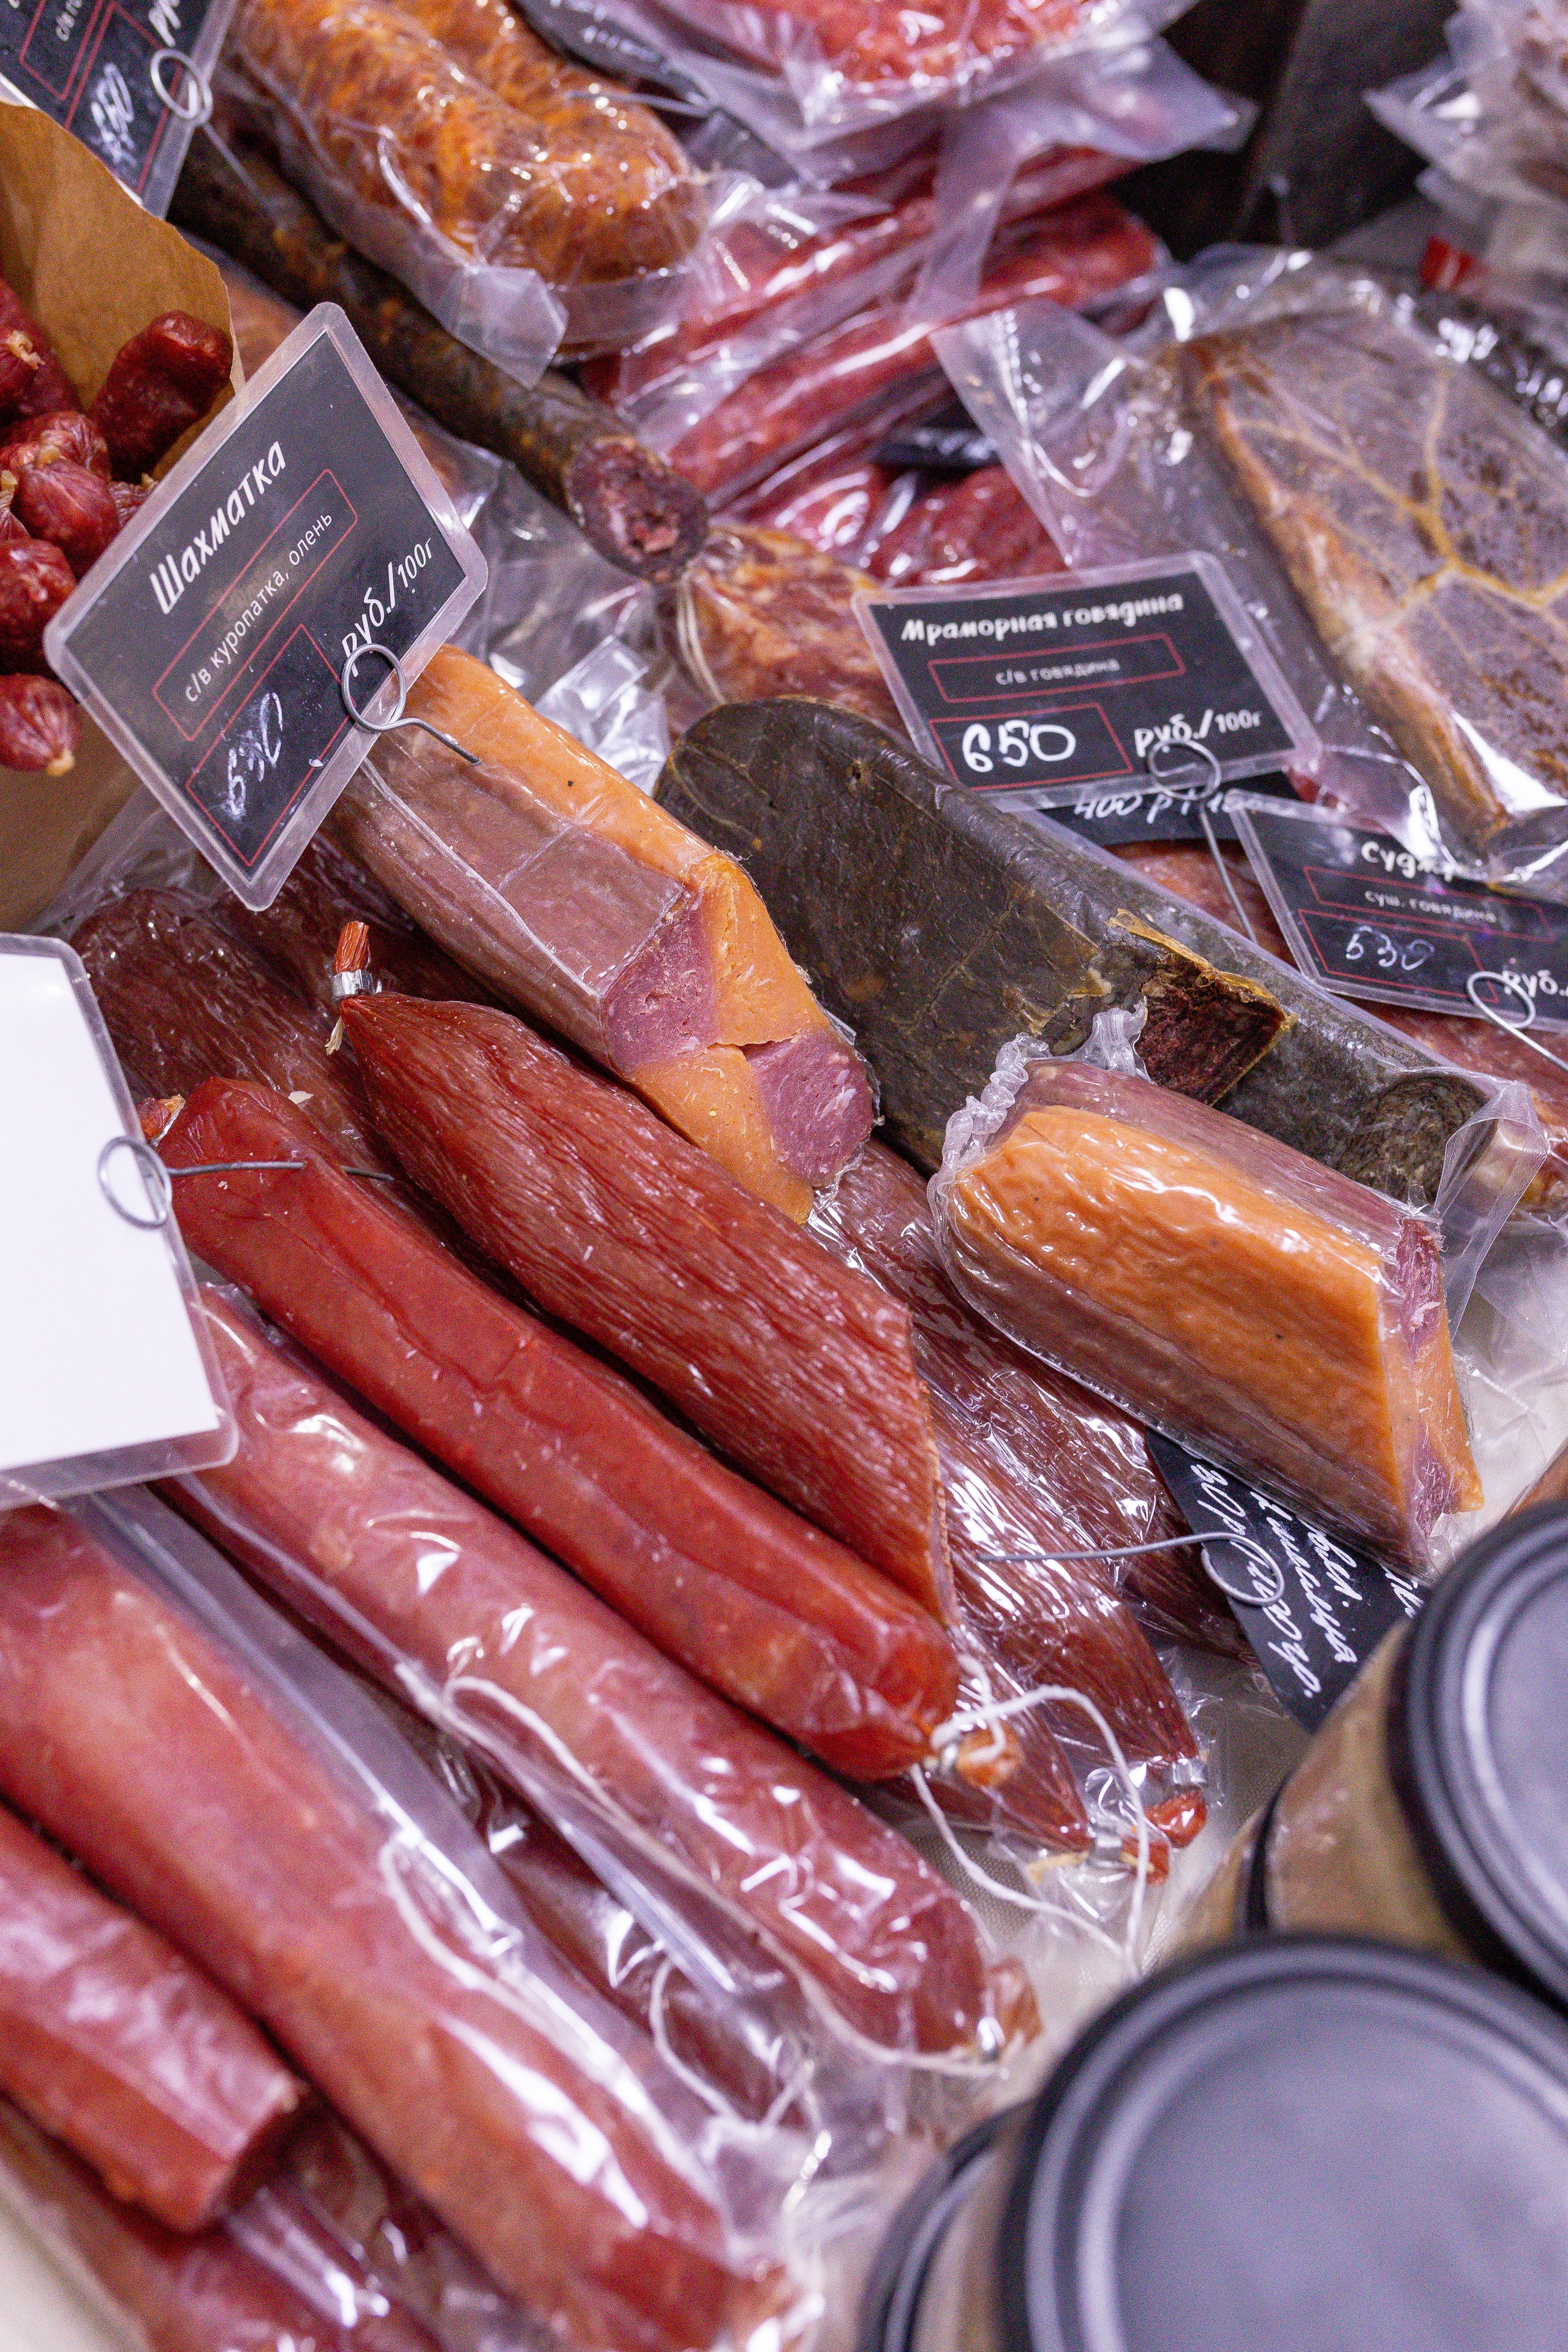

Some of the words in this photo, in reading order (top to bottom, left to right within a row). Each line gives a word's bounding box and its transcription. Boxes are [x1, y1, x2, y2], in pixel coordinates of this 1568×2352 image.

[149, 441, 286, 614] Шахматка
[185, 667, 212, 703] с/в
[210, 570, 290, 665] куропатка,
[288, 514, 333, 567] олень
[901, 612, 1058, 646] Мраморная
[1062, 593, 1184, 627] говядина
[1030, 658, 1120, 681] говядина
[962, 719, 1076, 772] 650
